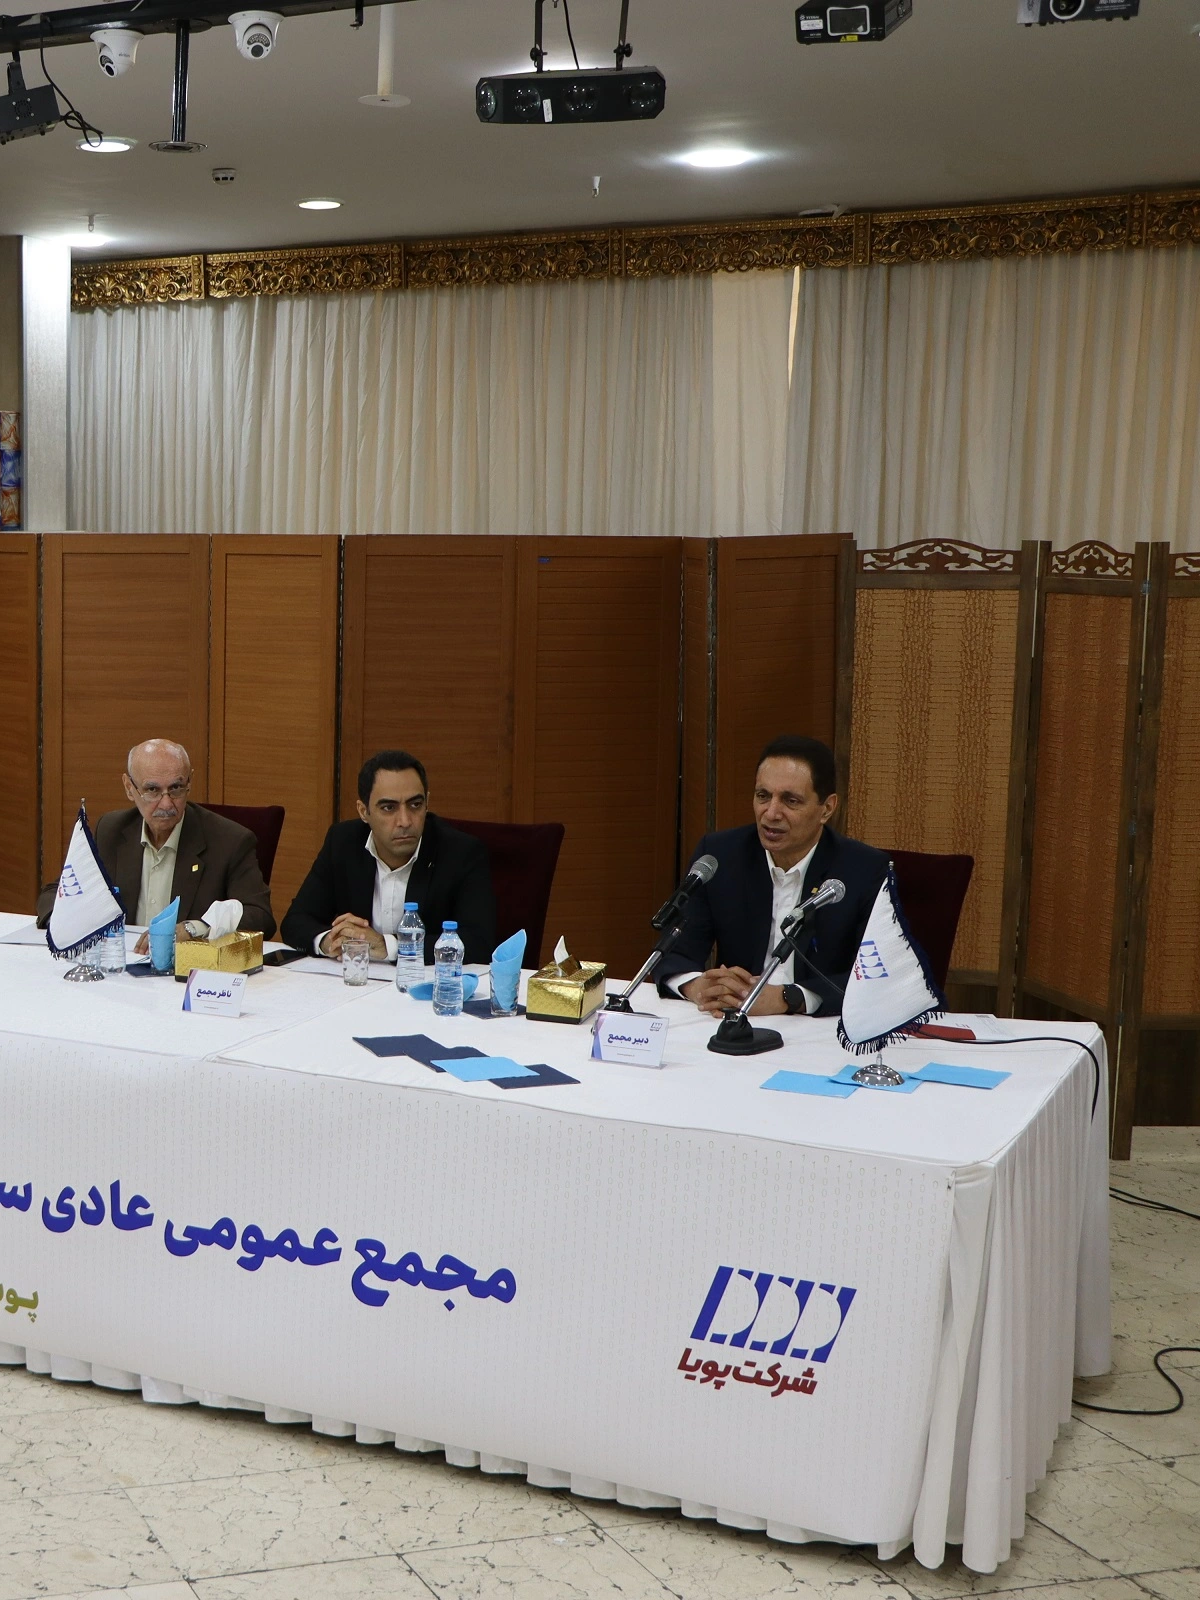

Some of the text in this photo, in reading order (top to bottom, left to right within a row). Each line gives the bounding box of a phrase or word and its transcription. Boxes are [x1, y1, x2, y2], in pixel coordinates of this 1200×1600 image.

[196, 988, 232, 998] ناظر مجمع
[607, 1033, 649, 1046] دبیر مجمع
[40, 1180, 155, 1233] عادی
[164, 1216, 342, 1271] عمومی
[351, 1237, 517, 1311] مجمع
[677, 1347, 818, 1398] شرکت پویا
